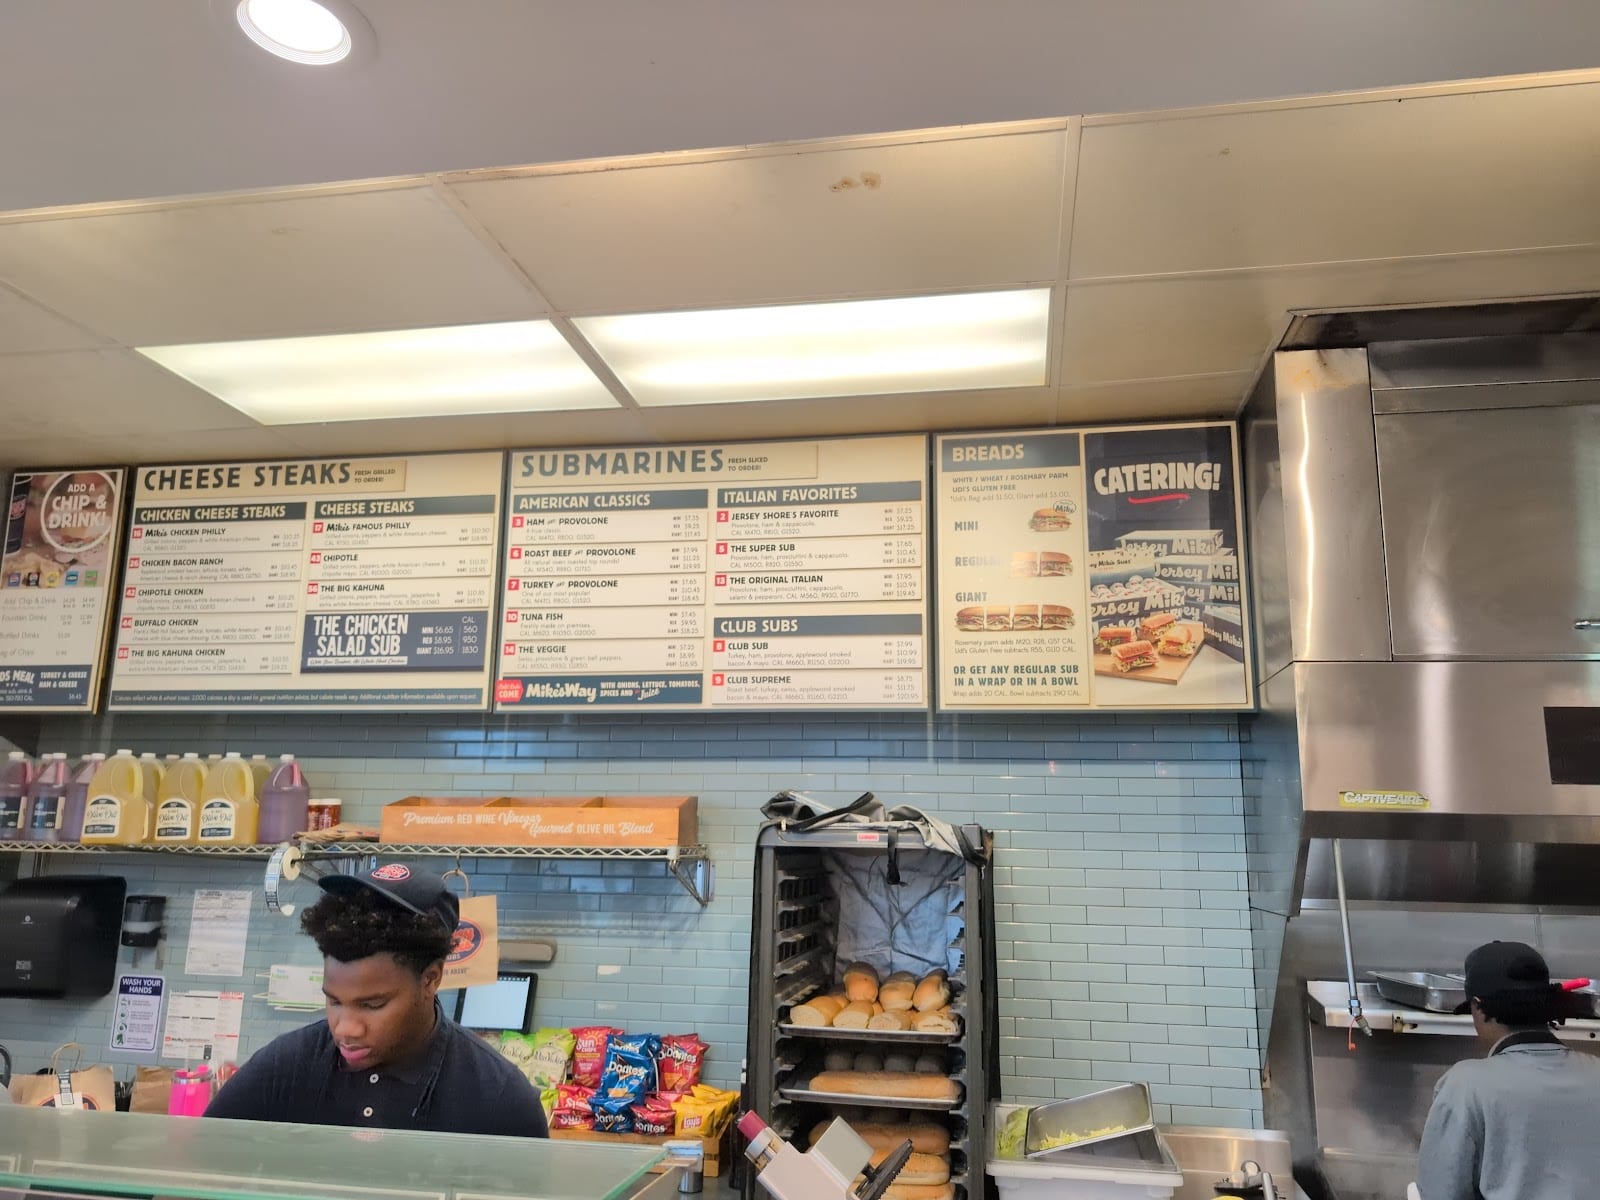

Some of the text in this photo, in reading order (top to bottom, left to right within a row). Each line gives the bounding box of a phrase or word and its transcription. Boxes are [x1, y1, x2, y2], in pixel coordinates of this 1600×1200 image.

[952, 444, 1024, 462] BREADS
[522, 448, 723, 477] SUBMARINES
[144, 462, 351, 491] CHEESE STEAKS
[1094, 462, 1221, 496] CATERING!
[67, 483, 96, 493] ADD A
[724, 487, 858, 504] ITALIAN FAVORITES
[51, 494, 106, 511] CHIP &
[520, 494, 650, 509] AMERICAN CLASSICS
[320, 500, 415, 516] CHEESE STEAKS
[140, 505, 286, 522] CHICKEN CHEESE STEAKS
[720, 510, 839, 521] 2 JERSEY SHORE'S FAVORITE
[48, 511, 106, 529] DRINK!
[527, 517, 608, 526] HAM PROVOLONE
[954, 521, 978, 531] MINI
[552, 549, 571, 557] BEEF
[586, 548, 636, 556] PROVOLONE
[731, 544, 795, 553] THE SUPER SUB
[142, 559, 170, 567] CHICKEN
[955, 556, 1003, 566] REGUL
[1154, 564, 1202, 581] Jersey
[511, 580, 618, 589] 7 TURKEY PROVOLONE
[716, 576, 725, 585] 13
[749, 576, 789, 584] ORIGINAL
[791, 575, 823, 583] ITALIAN
[337, 584, 350, 592] BIG
[955, 592, 988, 602] GIANT
[462, 616, 475, 624] CAL
[507, 613, 517, 621] 10
[521, 613, 543, 621] TUNA
[314, 614, 408, 636] THE CHICKEN
[434, 626, 453, 634] $6.65
[721, 619, 798, 633] CLUB SUBS
[434, 636, 452, 644] $8.95
[317, 636, 400, 656] SALAD SUB
[416, 647, 432, 655] GIANT
[519, 646, 534, 654] THE
[716, 642, 768, 650] 8 CLUB SUB
[954, 664, 1079, 674] OR GET ANY REGULAR SUB
[13, 670, 36, 685] MEAL
[40, 671, 62, 679] TURKEY
[68, 671, 88, 679] CHEESE
[715, 675, 721, 684] 9
[727, 676, 748, 684] CLUB
[954, 677, 1078, 686] IN A WRAP OR IN A BOWL
[403, 812, 542, 828] Premium RED WINE Vinegar
[529, 822, 654, 837] Gourmet OLIVE OIL Blend
[122, 978, 161, 987] WASH YOUR
[128, 986, 152, 994] HANDS
[576, 1038, 595, 1051] Sun
[667, 1048, 696, 1063] Doritos
[609, 1061, 646, 1077] Doritos
